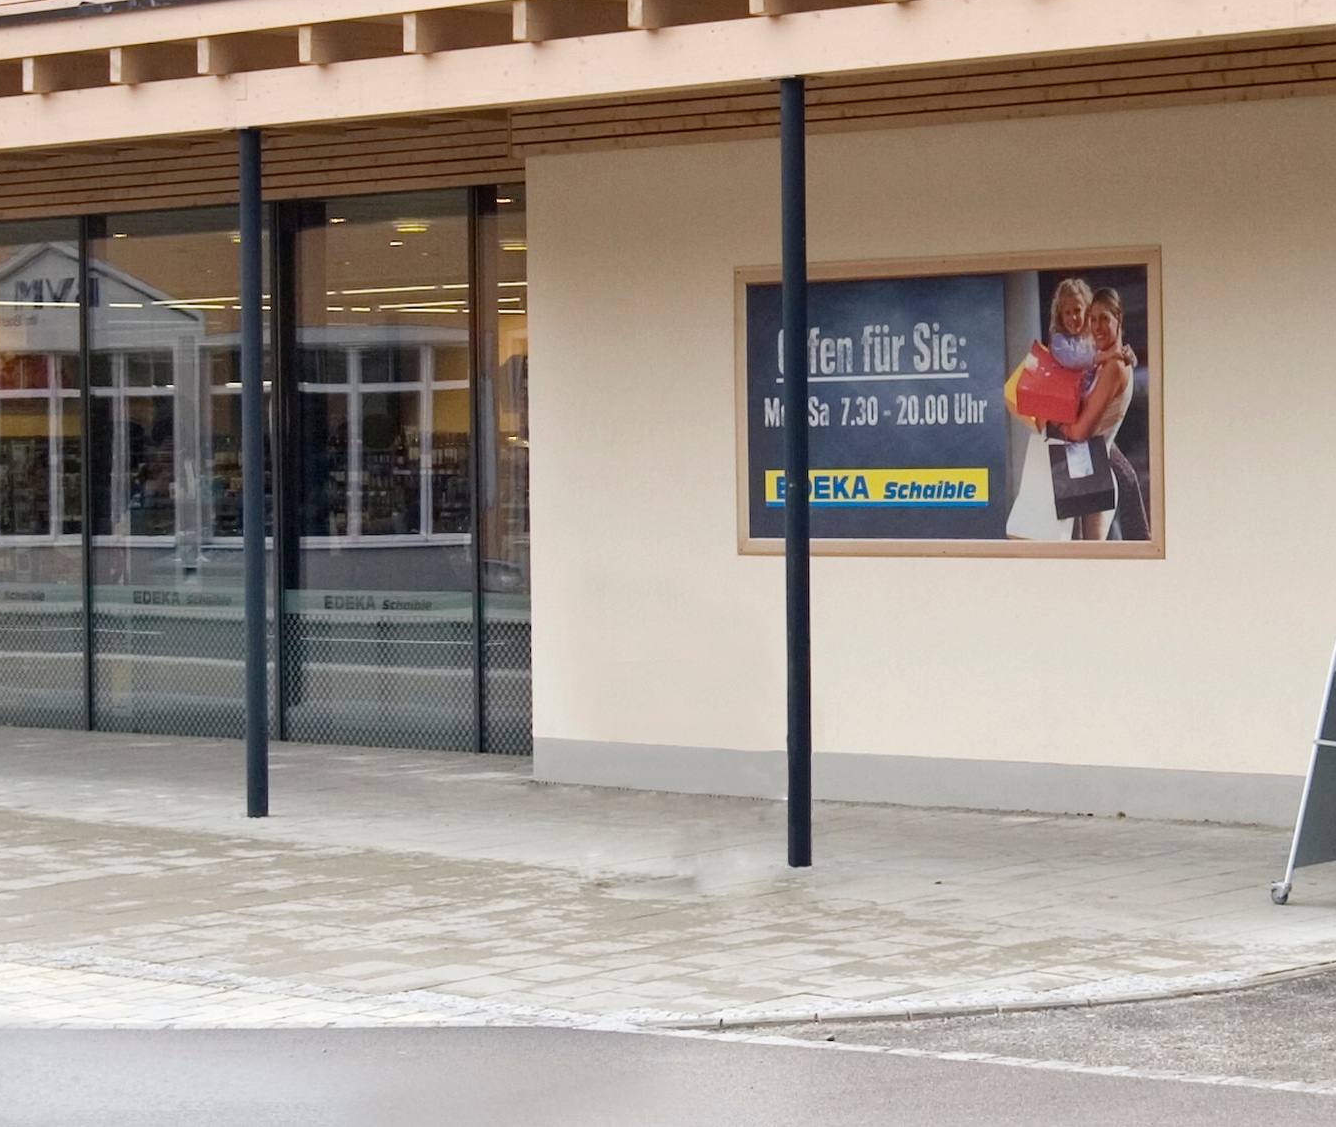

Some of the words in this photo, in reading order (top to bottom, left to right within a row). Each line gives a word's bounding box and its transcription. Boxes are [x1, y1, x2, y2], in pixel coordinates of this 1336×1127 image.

[777, 325, 854, 374] fen
[861, 324, 905, 373] für
[913, 322, 967, 372] Sie:
[841, 396, 878, 426] 7.30
[896, 394, 949, 425] 20.00
[954, 393, 987, 424] Uhr
[883, 480, 977, 499] Schaible
[132, 591, 180, 605] EDEKA
[324, 595, 375, 610] EDEKA
[382, 598, 433, 611] Schaible
